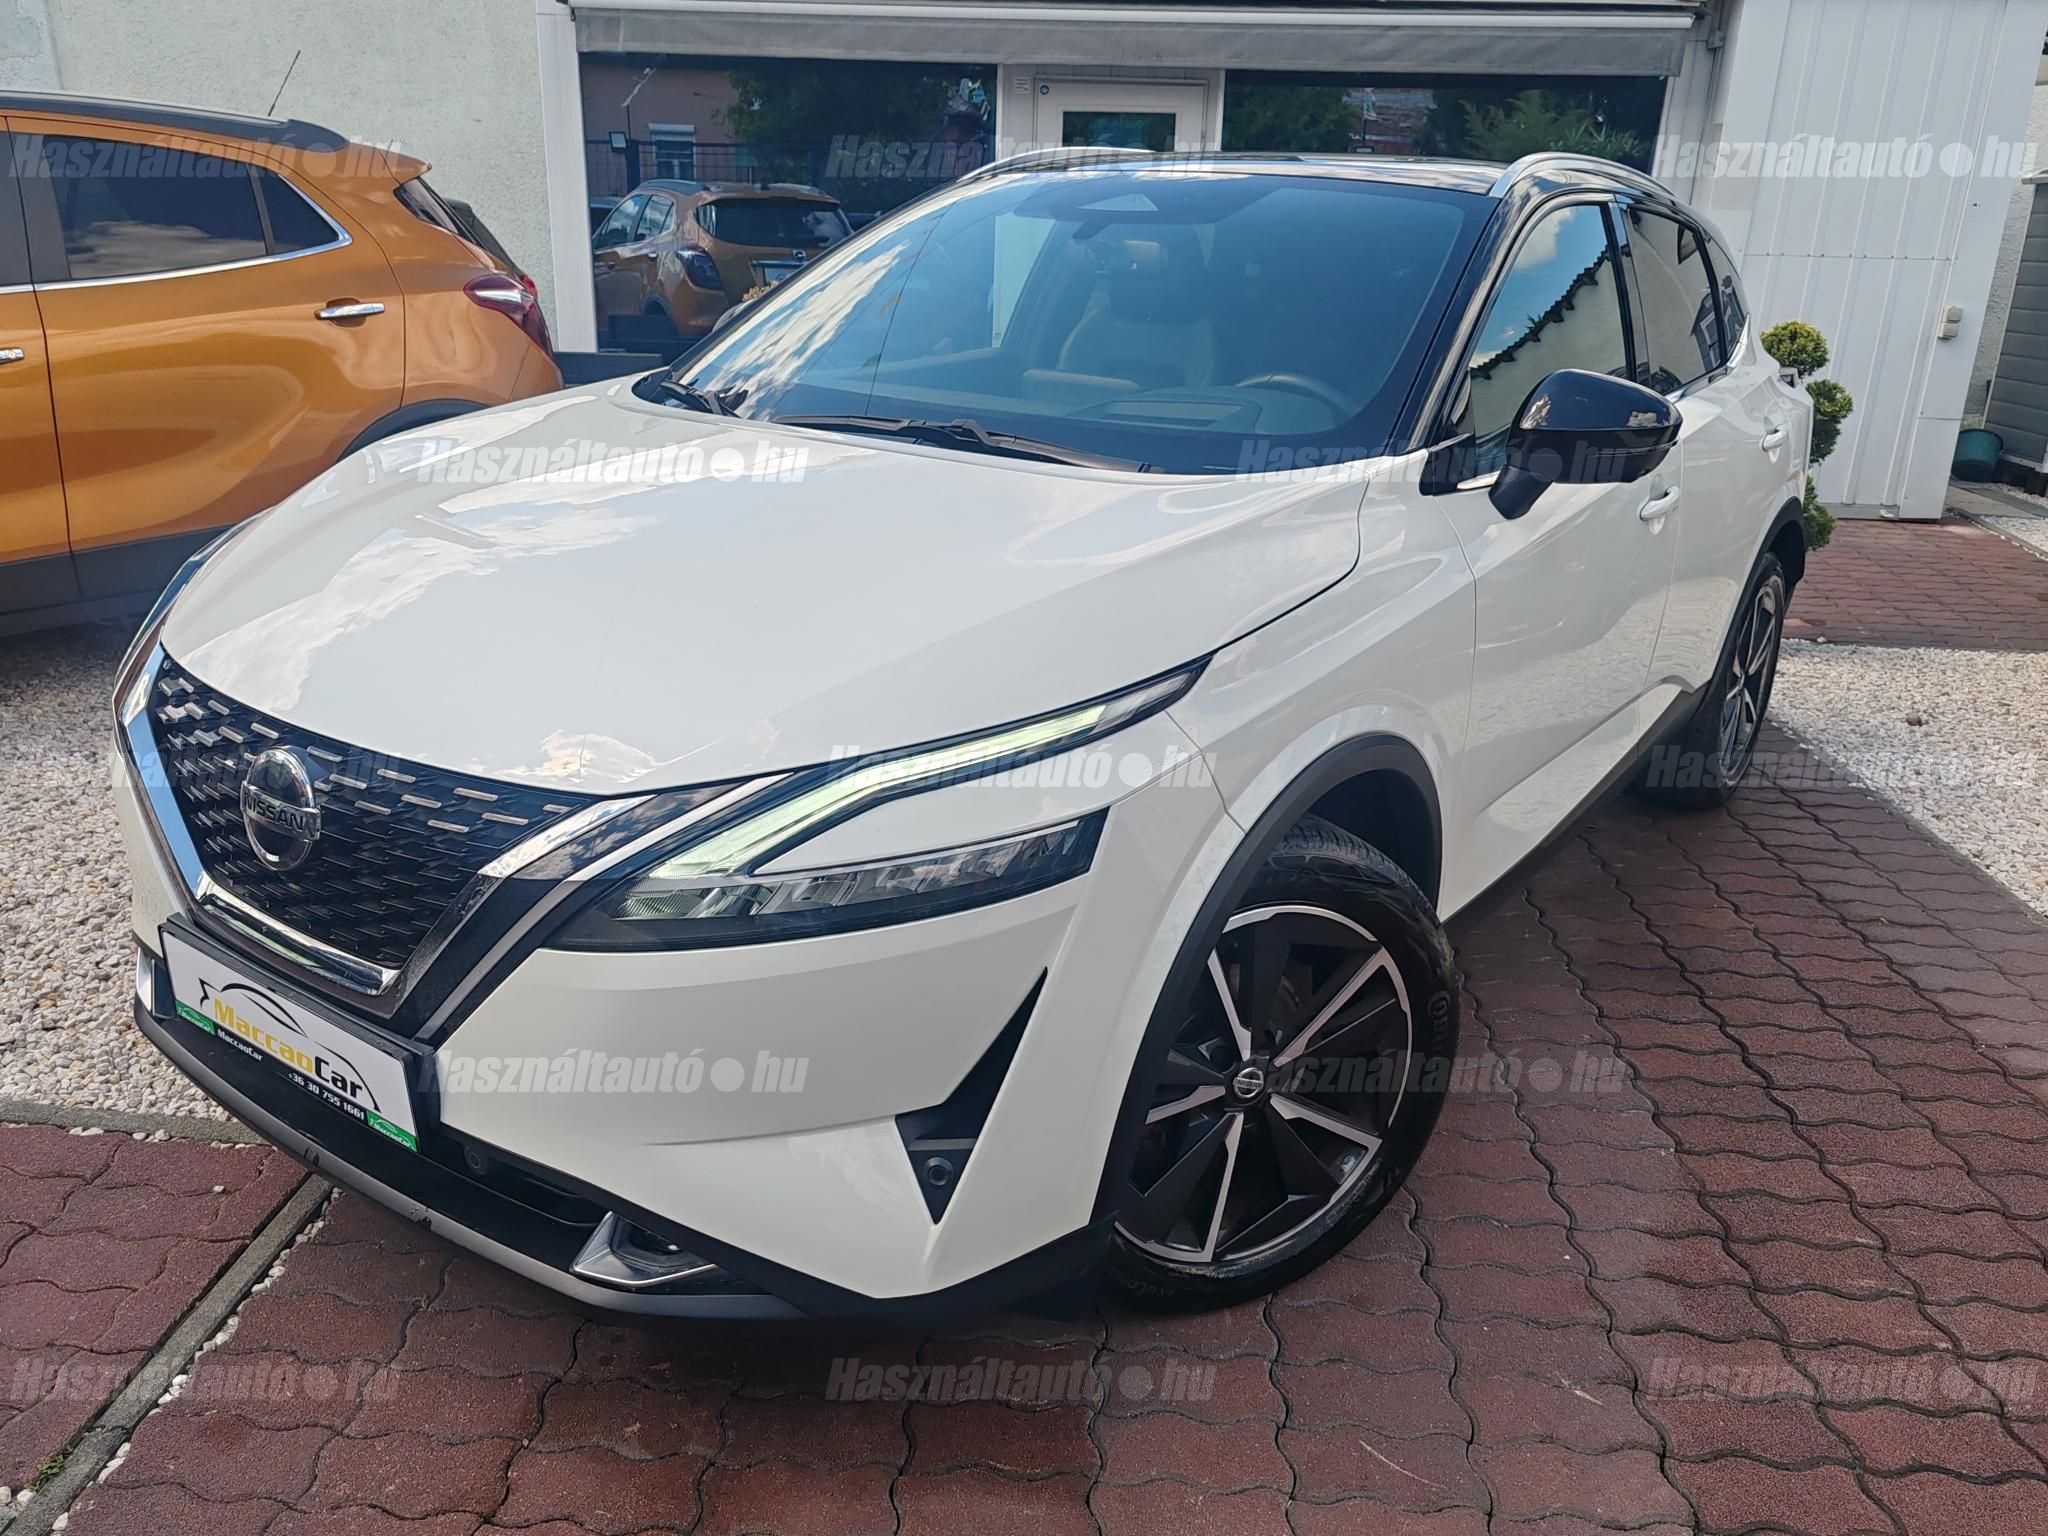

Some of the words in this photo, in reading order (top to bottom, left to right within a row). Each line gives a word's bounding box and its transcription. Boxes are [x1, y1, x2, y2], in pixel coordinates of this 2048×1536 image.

[244, 792, 304, 832] NISSAN
[214, 996, 363, 1100] MaccaoCar
[217, 1028, 264, 1062] MaccaoCar
[288, 1072, 305, 1087] +36
[307, 1080, 320, 1095] 30
[322, 1089, 341, 1106] 755
[343, 1102, 365, 1121] 1661
